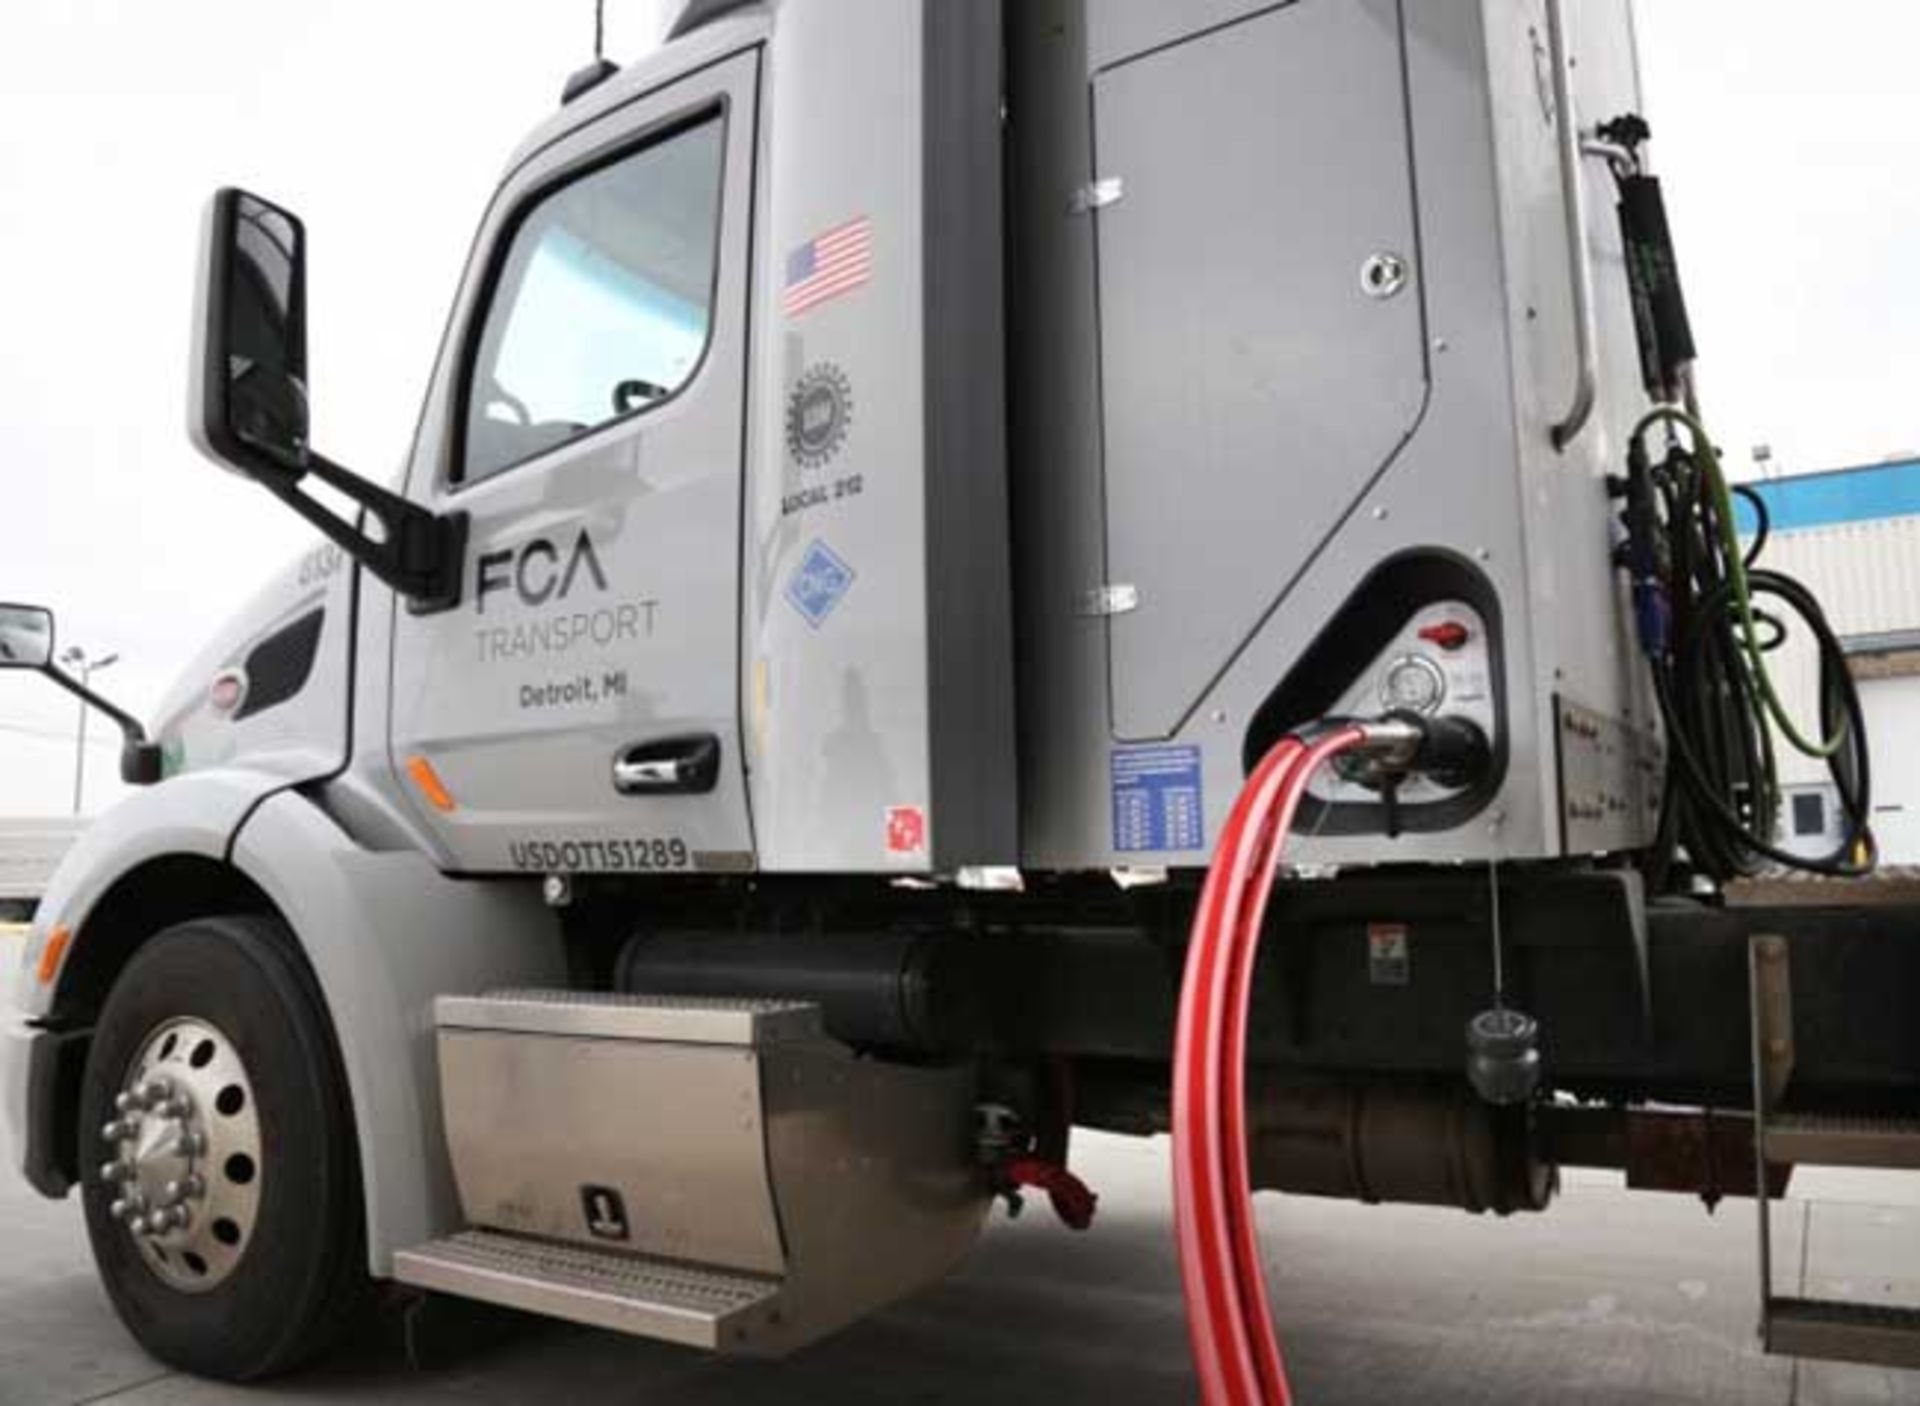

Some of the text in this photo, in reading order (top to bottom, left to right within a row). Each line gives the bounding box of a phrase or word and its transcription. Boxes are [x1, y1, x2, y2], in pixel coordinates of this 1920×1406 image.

[476, 528, 608, 616] FCA
[475, 601, 660, 662] TRANSPORT
[520, 670, 628, 708] Detroit, MI
[510, 838, 687, 868] USDOT151289
